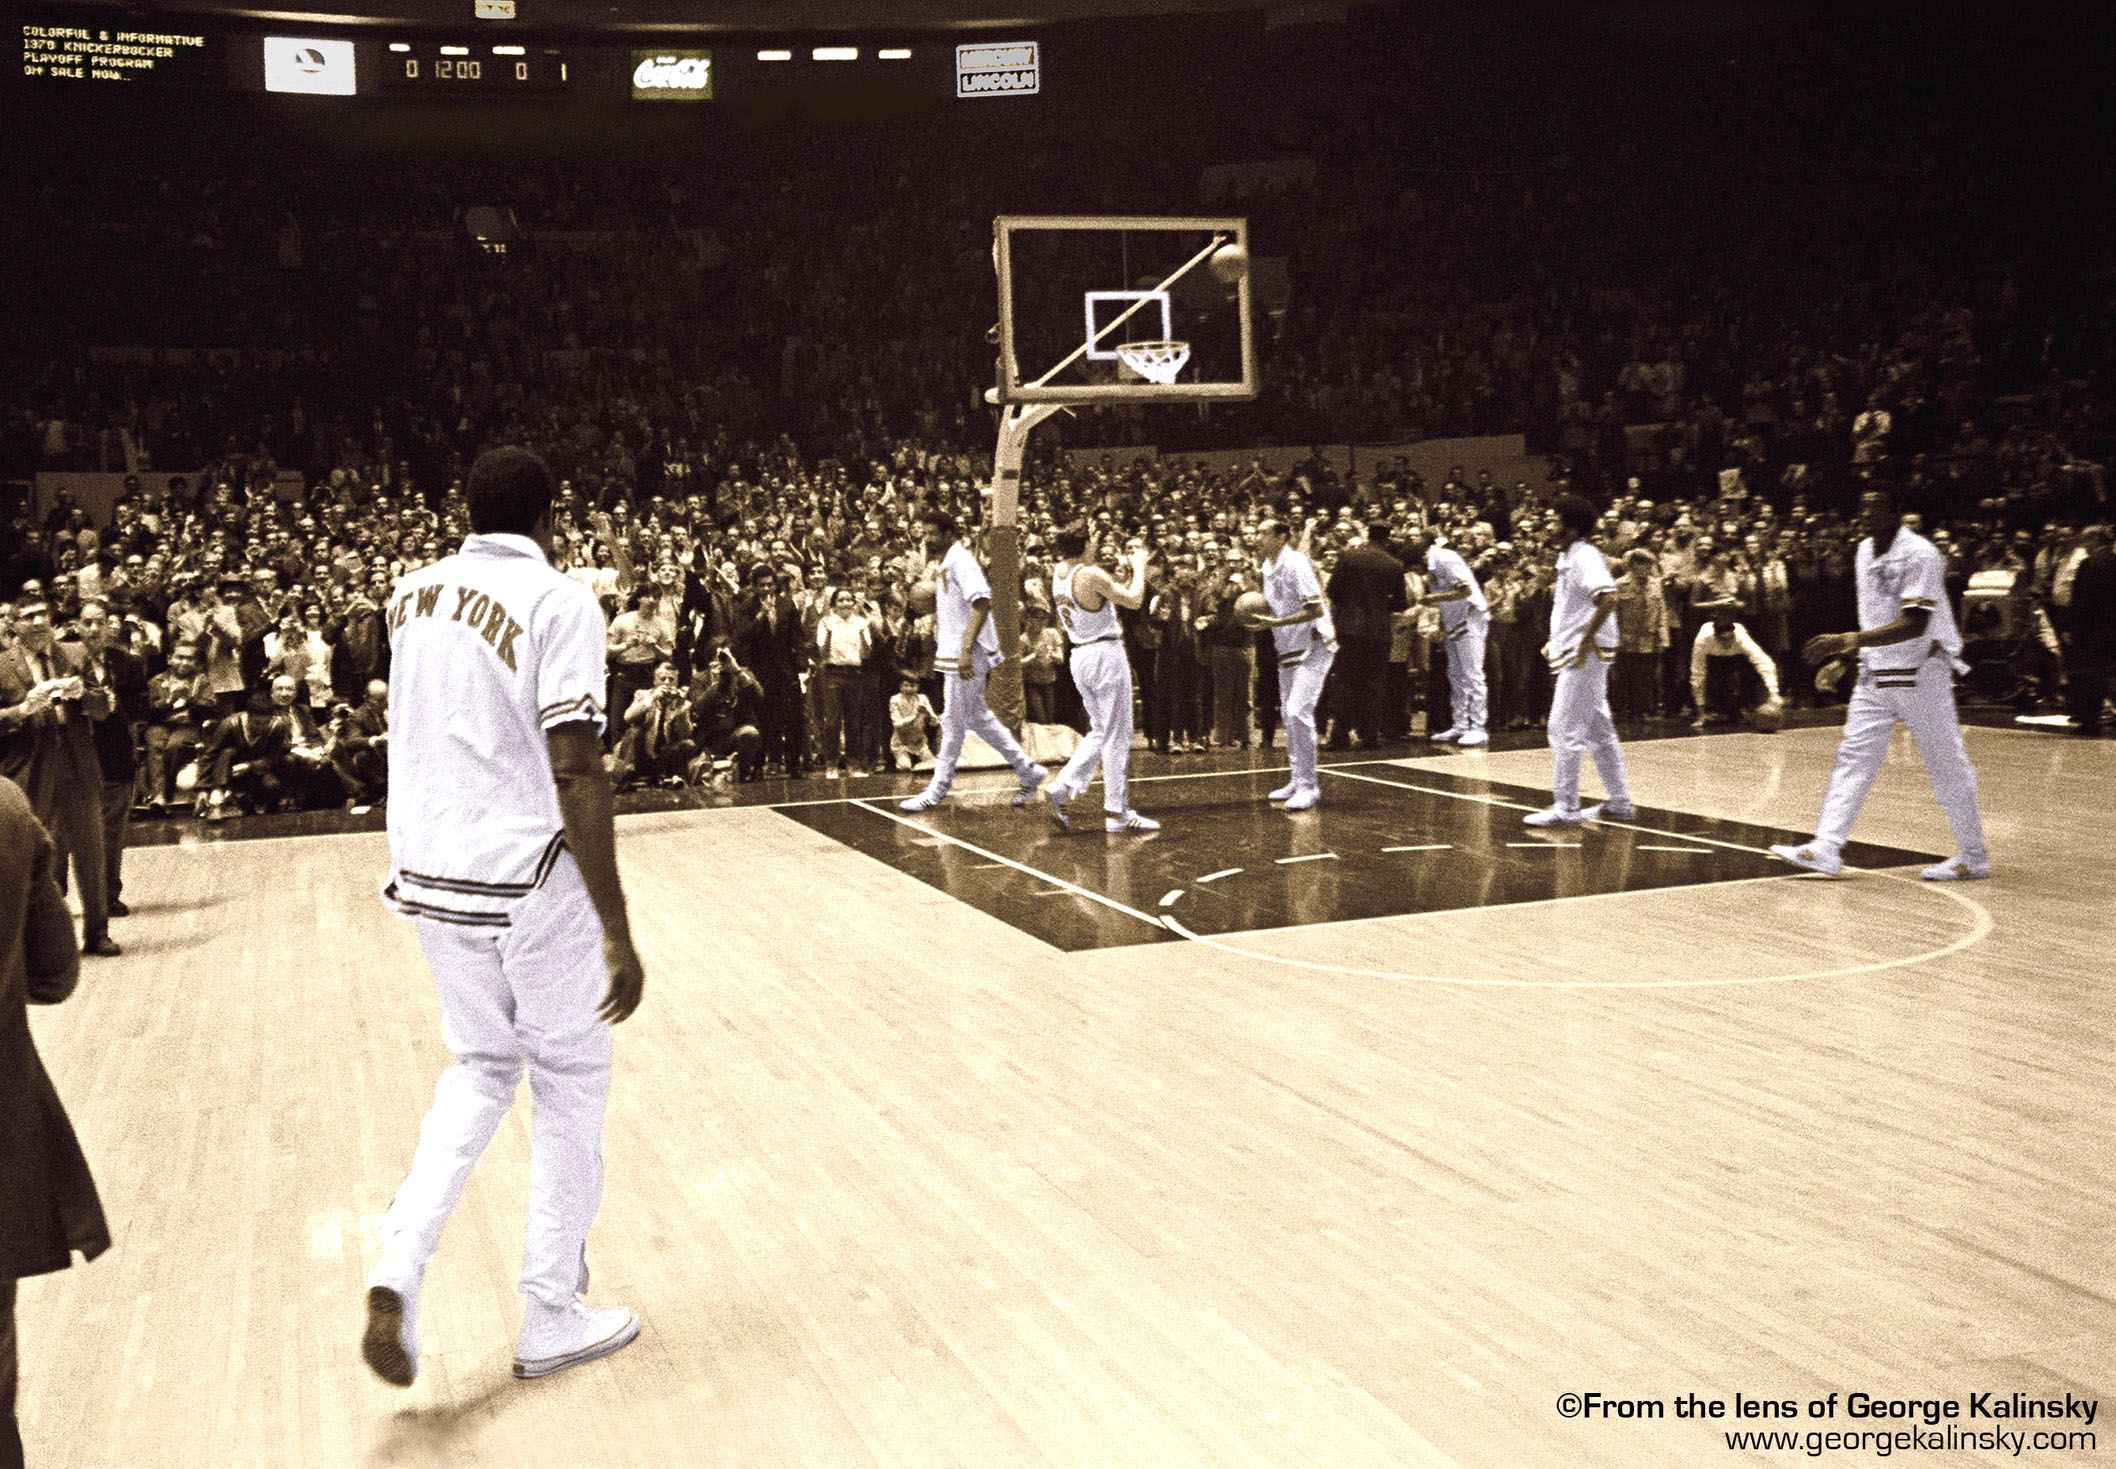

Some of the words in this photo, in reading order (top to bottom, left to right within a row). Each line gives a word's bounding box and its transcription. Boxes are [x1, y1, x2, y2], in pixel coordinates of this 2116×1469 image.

[23, 26, 91, 40] COLORFUL
[116, 32, 205, 47] INFORMATIVE
[63, 41, 174, 58] KNICKERBOCKER
[24, 52, 83, 65] PLAYOFF
[91, 56, 154, 69] PROGRAM
[406, 60, 418, 78] 0
[516, 62, 528, 80] 0
[50, 67, 85, 78] SALE
[962, 71, 1034, 92] LINCOLN
[450, 585, 524, 673] YORK
